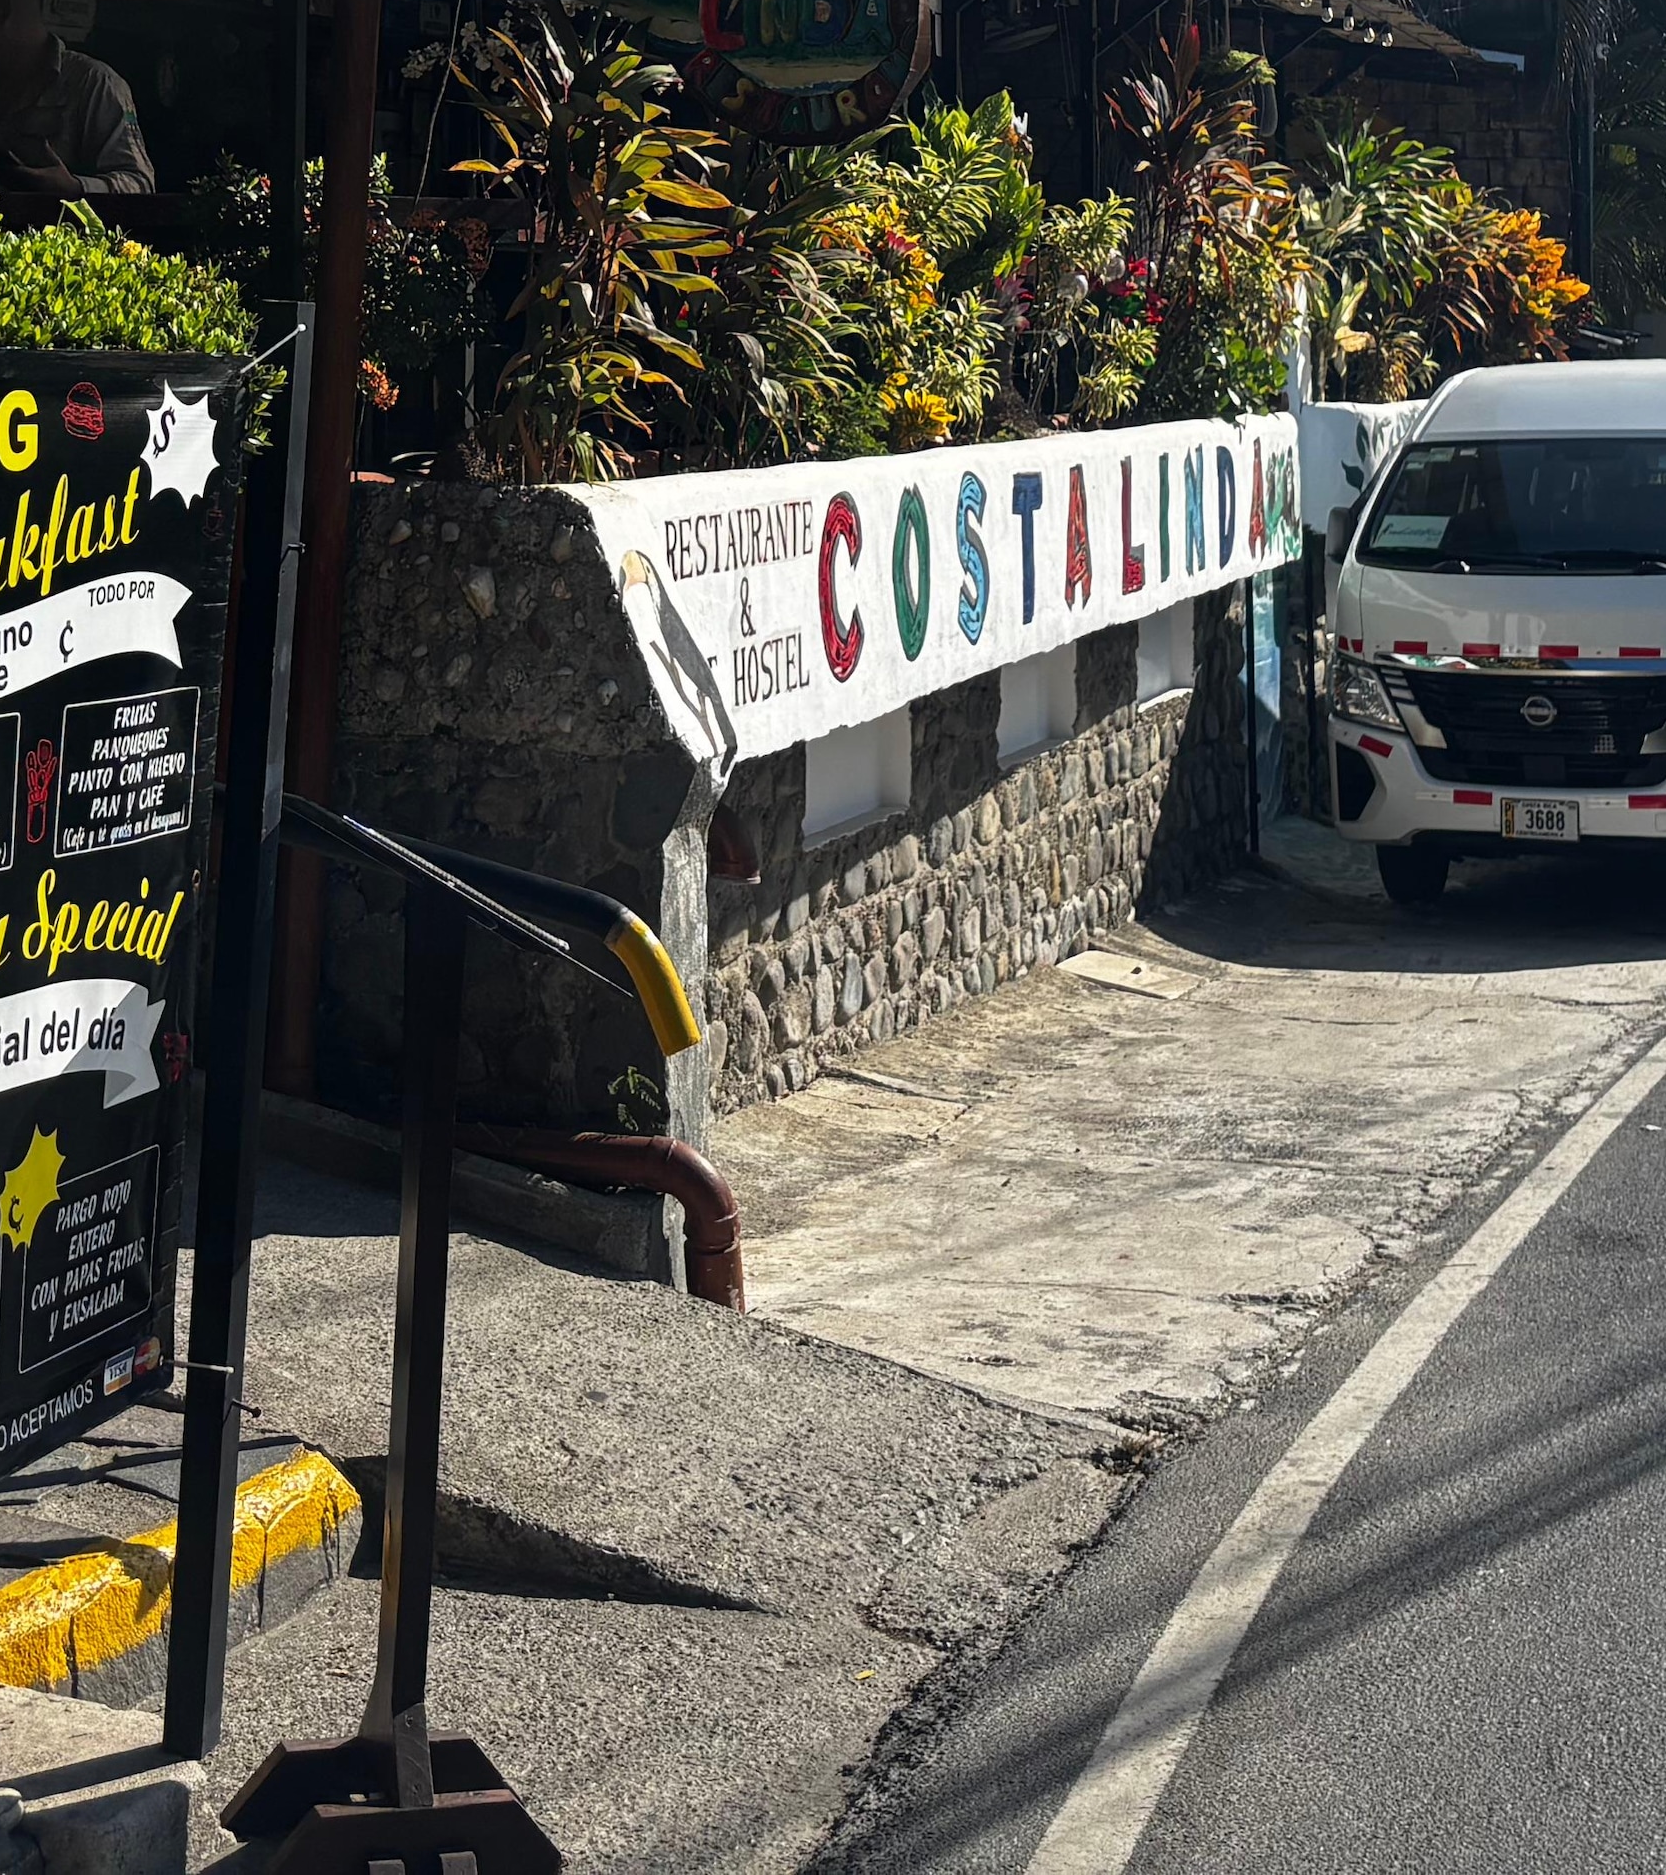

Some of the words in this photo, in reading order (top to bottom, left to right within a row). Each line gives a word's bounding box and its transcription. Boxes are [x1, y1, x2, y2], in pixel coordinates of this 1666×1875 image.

[153, 404, 176, 458] $
[664, 500, 815, 583] RESTAURANTE
[88, 582, 126, 607] TODO
[129, 580, 155, 601] POR
[739, 577, 756, 638] &
[733, 632, 810, 708] HOSTEL
[114, 701, 157, 729] FRUTAS
[91, 727, 170, 762] PANQUEQUES
[68, 767, 113, 795] PINTO
[119, 761, 144, 786] CON
[90, 794, 121, 820] PAN
[1525, 809, 1565, 831] 3688
[22, 869, 185, 977] Special
[39, 1007, 80, 1056] del
[88, 1005, 126, 1051] día
[55, 1194, 97, 1233] PARGO
[102, 1179, 132, 1214] ROJO
[68, 1219, 116, 1262] ENTERO
[31, 1276, 59, 1311] CON
[63, 1256, 103, 1296] PAPAS
[106, 1236, 146, 1277] FRITAS
[63, 1279, 125, 1331] ENSALADA
[109, 1361, 128, 1382] VISA
[9, 1378, 94, 1446] ACEPTAMOS
